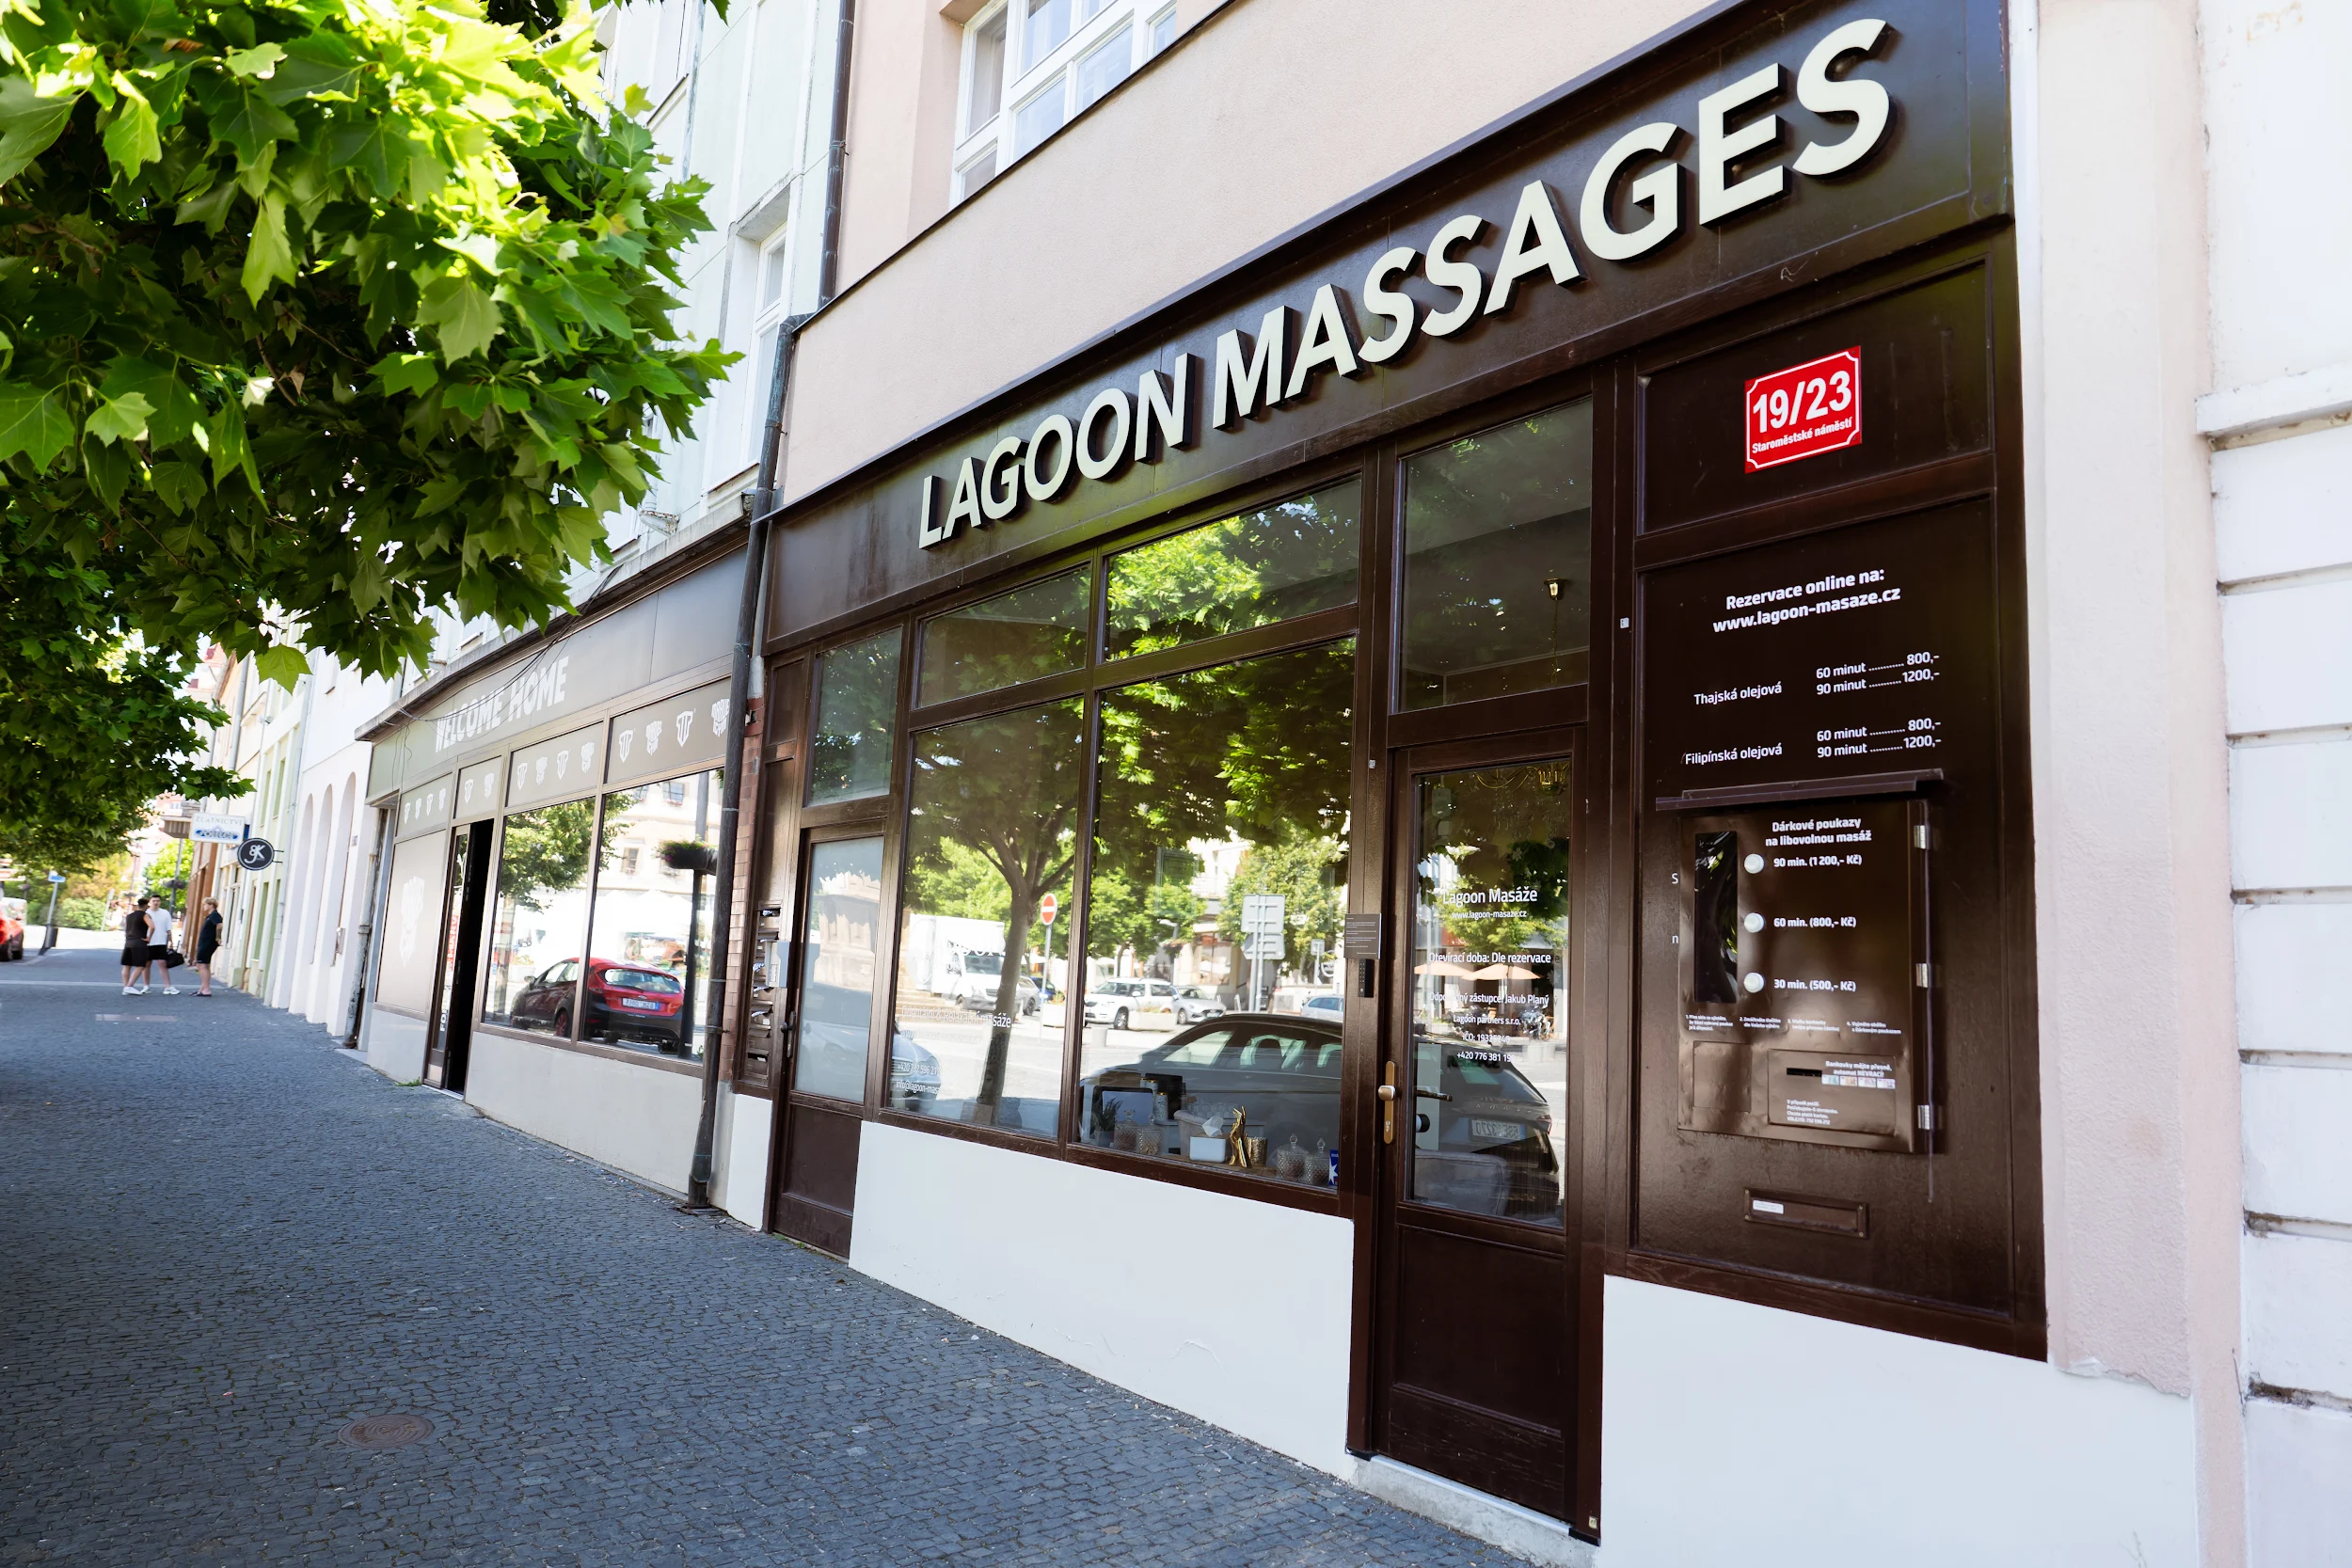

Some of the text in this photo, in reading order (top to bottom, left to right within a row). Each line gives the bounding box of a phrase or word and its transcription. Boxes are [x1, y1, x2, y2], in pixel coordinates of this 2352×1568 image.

[918, 17, 1889, 549] LAGOON MASSAGES
[1753, 371, 1852, 434] 19/23
[1752, 417, 1852, 453] Staroměstské náměstí
[1725, 568, 1885, 610] Rezervace online na:
[1713, 587, 1901, 633] www.lagoon-masaze.cz
[1816, 667, 1831, 680] 60
[1833, 662, 1867, 677] minut
[1694, 680, 1783, 705] Thajská olejová
[1816, 683, 1832, 696] 90
[1833, 678, 1867, 693] minut
[436, 656, 569, 753] WELCOME HOME
[1817, 729, 1832, 742] 60
[1834, 726, 1867, 740] minut
[1685, 743, 1783, 766] Filipínská olejová
[1817, 746, 1833, 758] 90
[1834, 742, 1867, 757] minut
[1772, 817, 1862, 832] Dárkové poukazy
[1765, 830, 1872, 847] na libovolnou masáž
[1773, 857, 1786, 867] 90
[1788, 856, 1807, 867] min.
[1846, 854, 1863, 866] Kč)
[1442, 885, 1538, 908] Lagoon Masáže
[1452, 909, 1527, 921] www.lagoon-masaze.cz
[1773, 917, 1786, 927] 60
[1788, 916, 1808, 927] min.
[1840, 916, 1857, 928] Kč)
[1429, 951, 1551, 964] Otevírací doba: Dle rezervace
[1773, 978, 1786, 989] 30
[1788, 979, 1808, 990] min.
[1840, 980, 1857, 992] Kč)
[1504, 994, 1526, 1005] Jakub
[1528, 994, 1549, 1006] Planý
[1453, 1014, 1476, 1025] Lagoon
[1474, 1052, 1488, 1061] 776
[1488, 1053, 1502, 1062] 381
